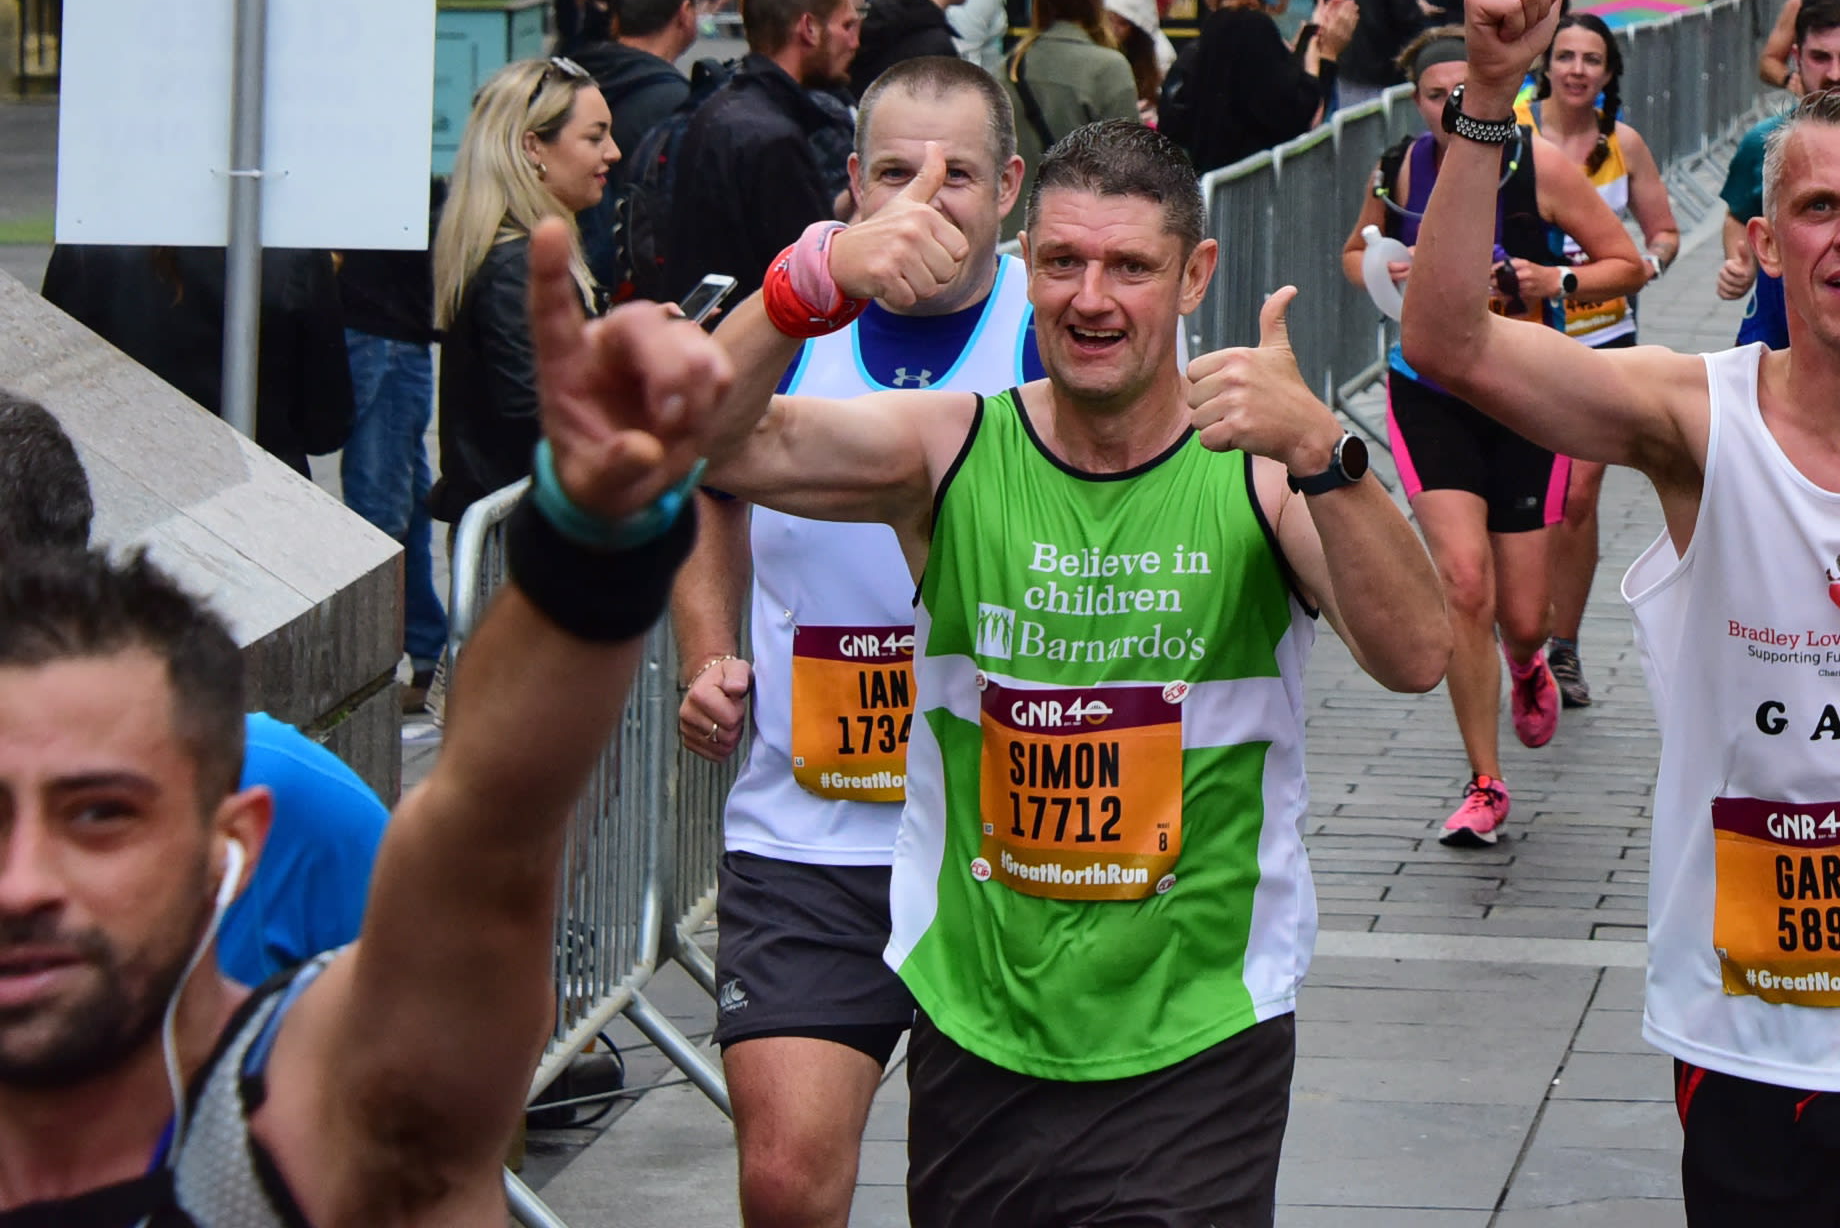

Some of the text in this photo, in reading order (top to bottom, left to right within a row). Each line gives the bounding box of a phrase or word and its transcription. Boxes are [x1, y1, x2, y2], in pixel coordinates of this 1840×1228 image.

[1028, 540, 1212, 579] Believe in
[1023, 581, 1183, 617] children
[1016, 620, 1207, 663] Barnardo's
[1727, 620, 1801, 650] Bradley
[1747, 645, 1821, 666] Supporting
[858, 670, 910, 710] IAN
[1009, 740, 1120, 790] SIMON
[1009, 791, 1122, 843] 17712
[1158, 832, 1168, 852] 8
[1000, 849, 1149, 885] #GreatNorthRun
